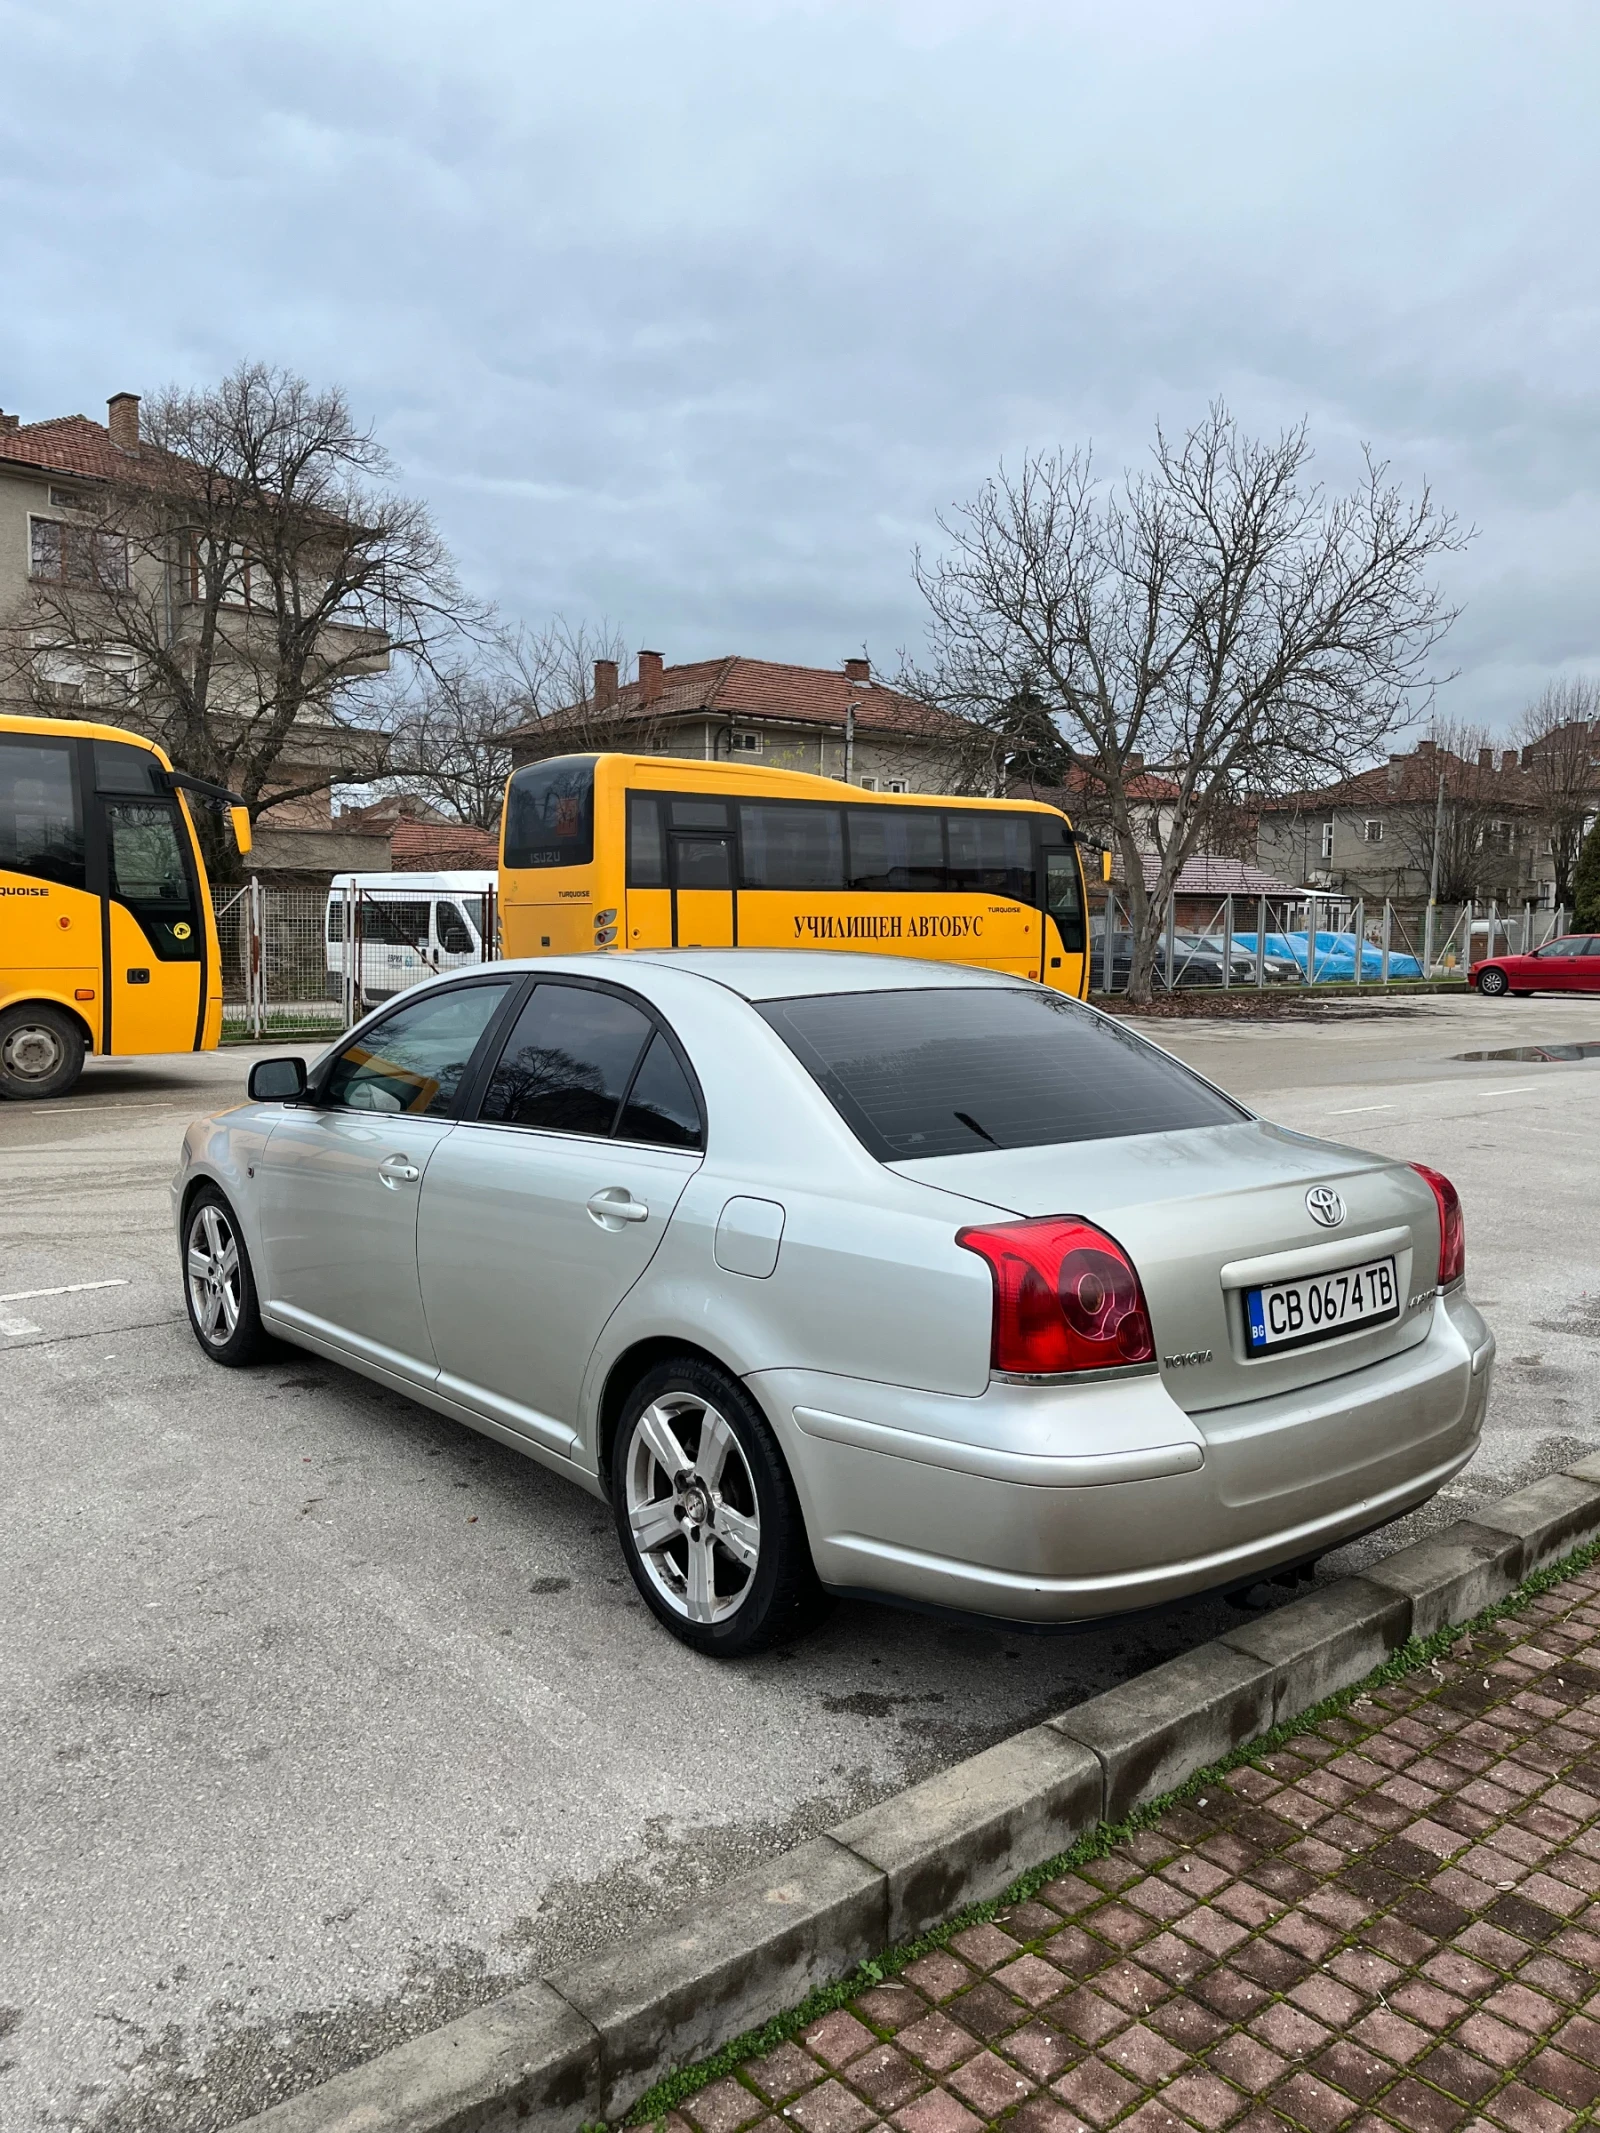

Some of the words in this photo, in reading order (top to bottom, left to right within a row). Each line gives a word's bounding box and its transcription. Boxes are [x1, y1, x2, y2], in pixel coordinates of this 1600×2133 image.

[530, 851, 561, 864] ISUZU
[558, 890, 590, 899] TURQUOISE
[987, 906, 1021, 914] TURQUOISE
[794, 915, 903, 942] УЧИЛИЩЕН
[907, 915, 984, 938] АВТОБУС
[1252, 1325, 1265, 1339] BG
[1163, 1349, 1213, 1369] TOYOTA
